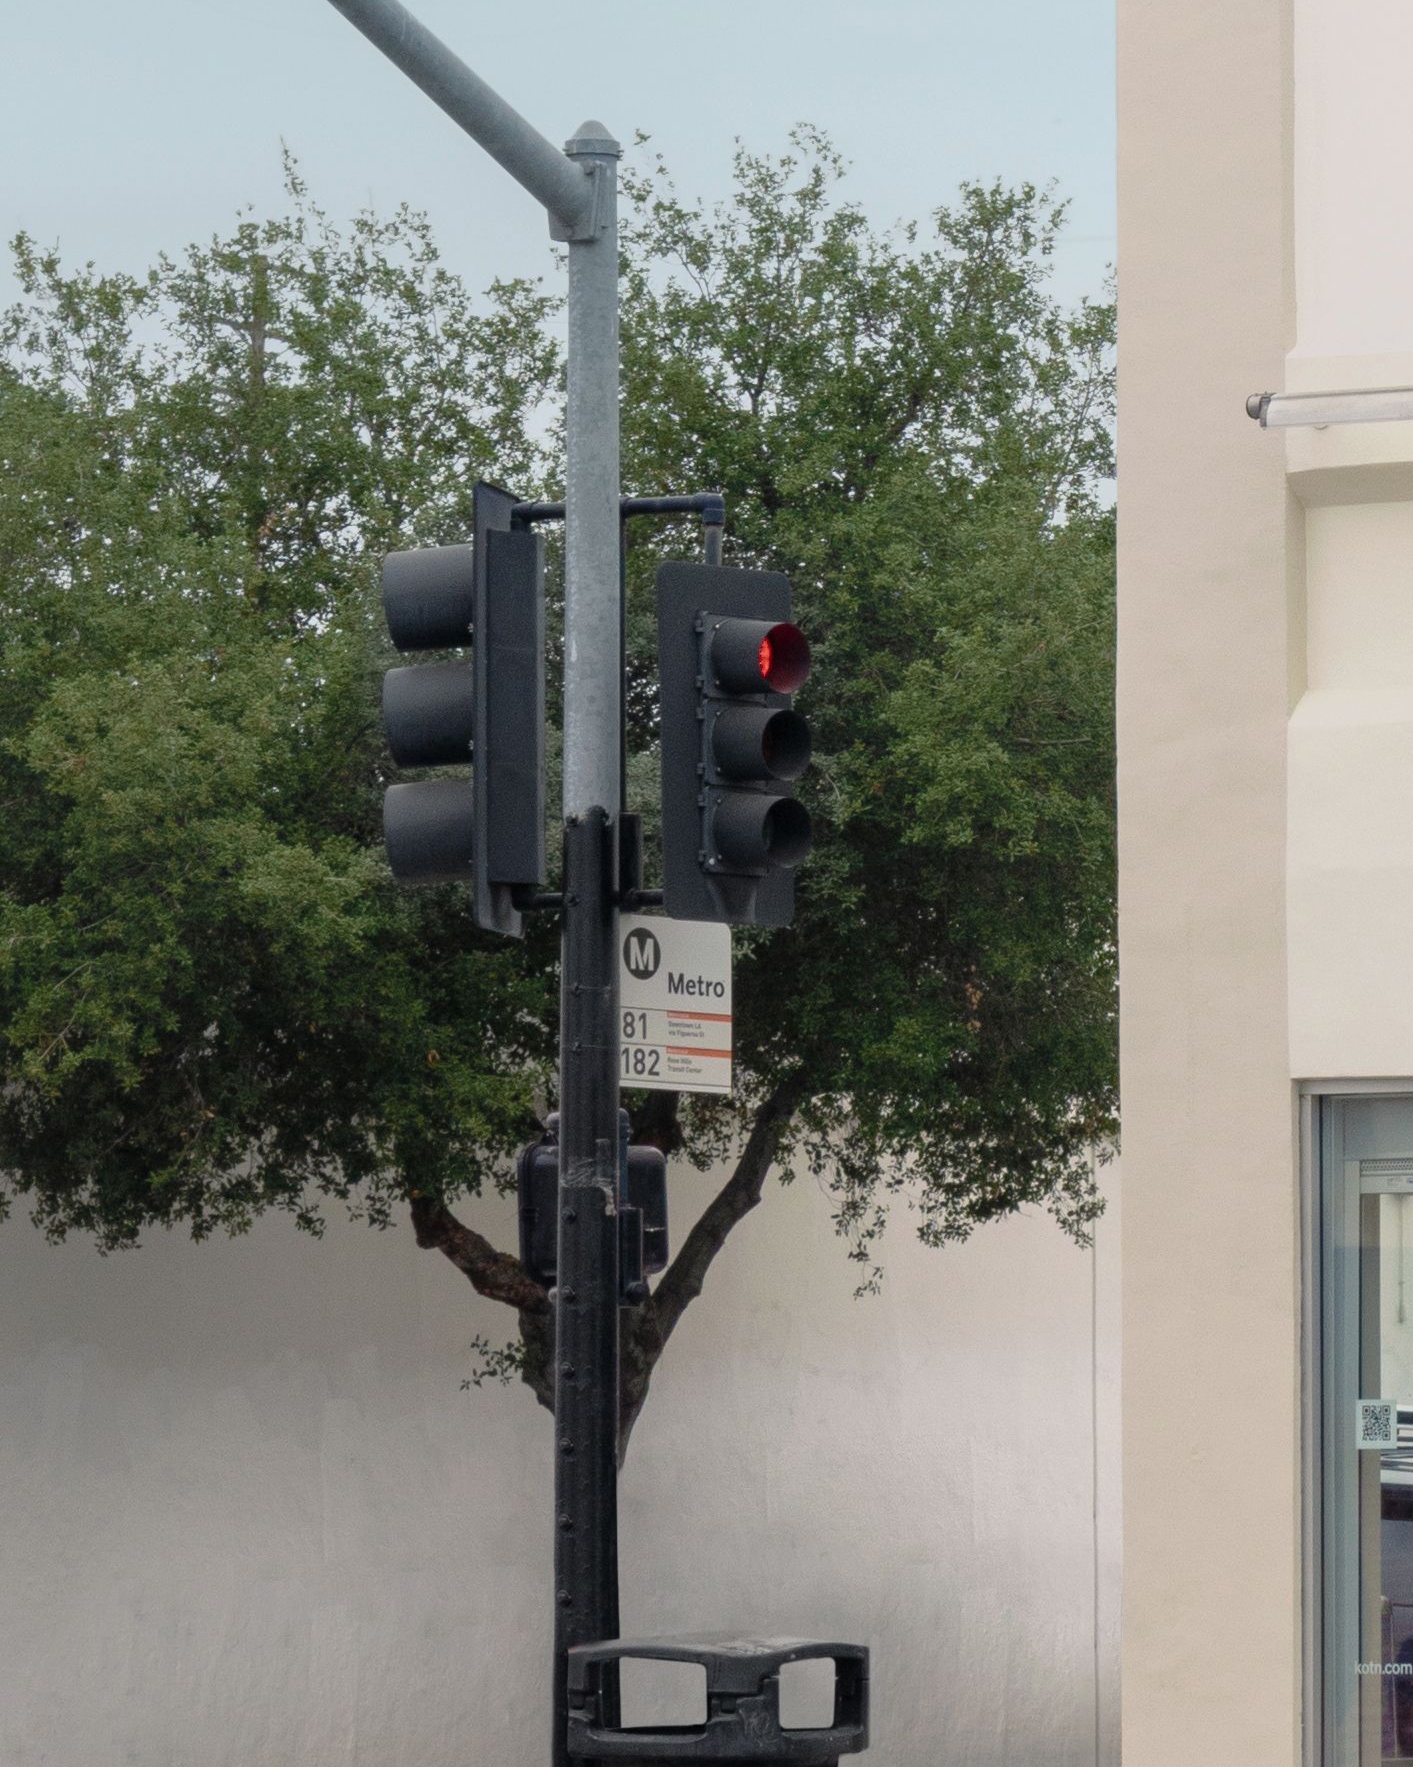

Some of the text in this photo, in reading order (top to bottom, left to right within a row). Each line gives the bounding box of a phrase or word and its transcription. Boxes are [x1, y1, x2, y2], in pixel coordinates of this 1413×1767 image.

[667, 972, 725, 998] Metro
[622, 1011, 647, 1040] 81
[621, 1047, 660, 1076] 182
[1354, 1660, 1413, 1675] kotn.com
